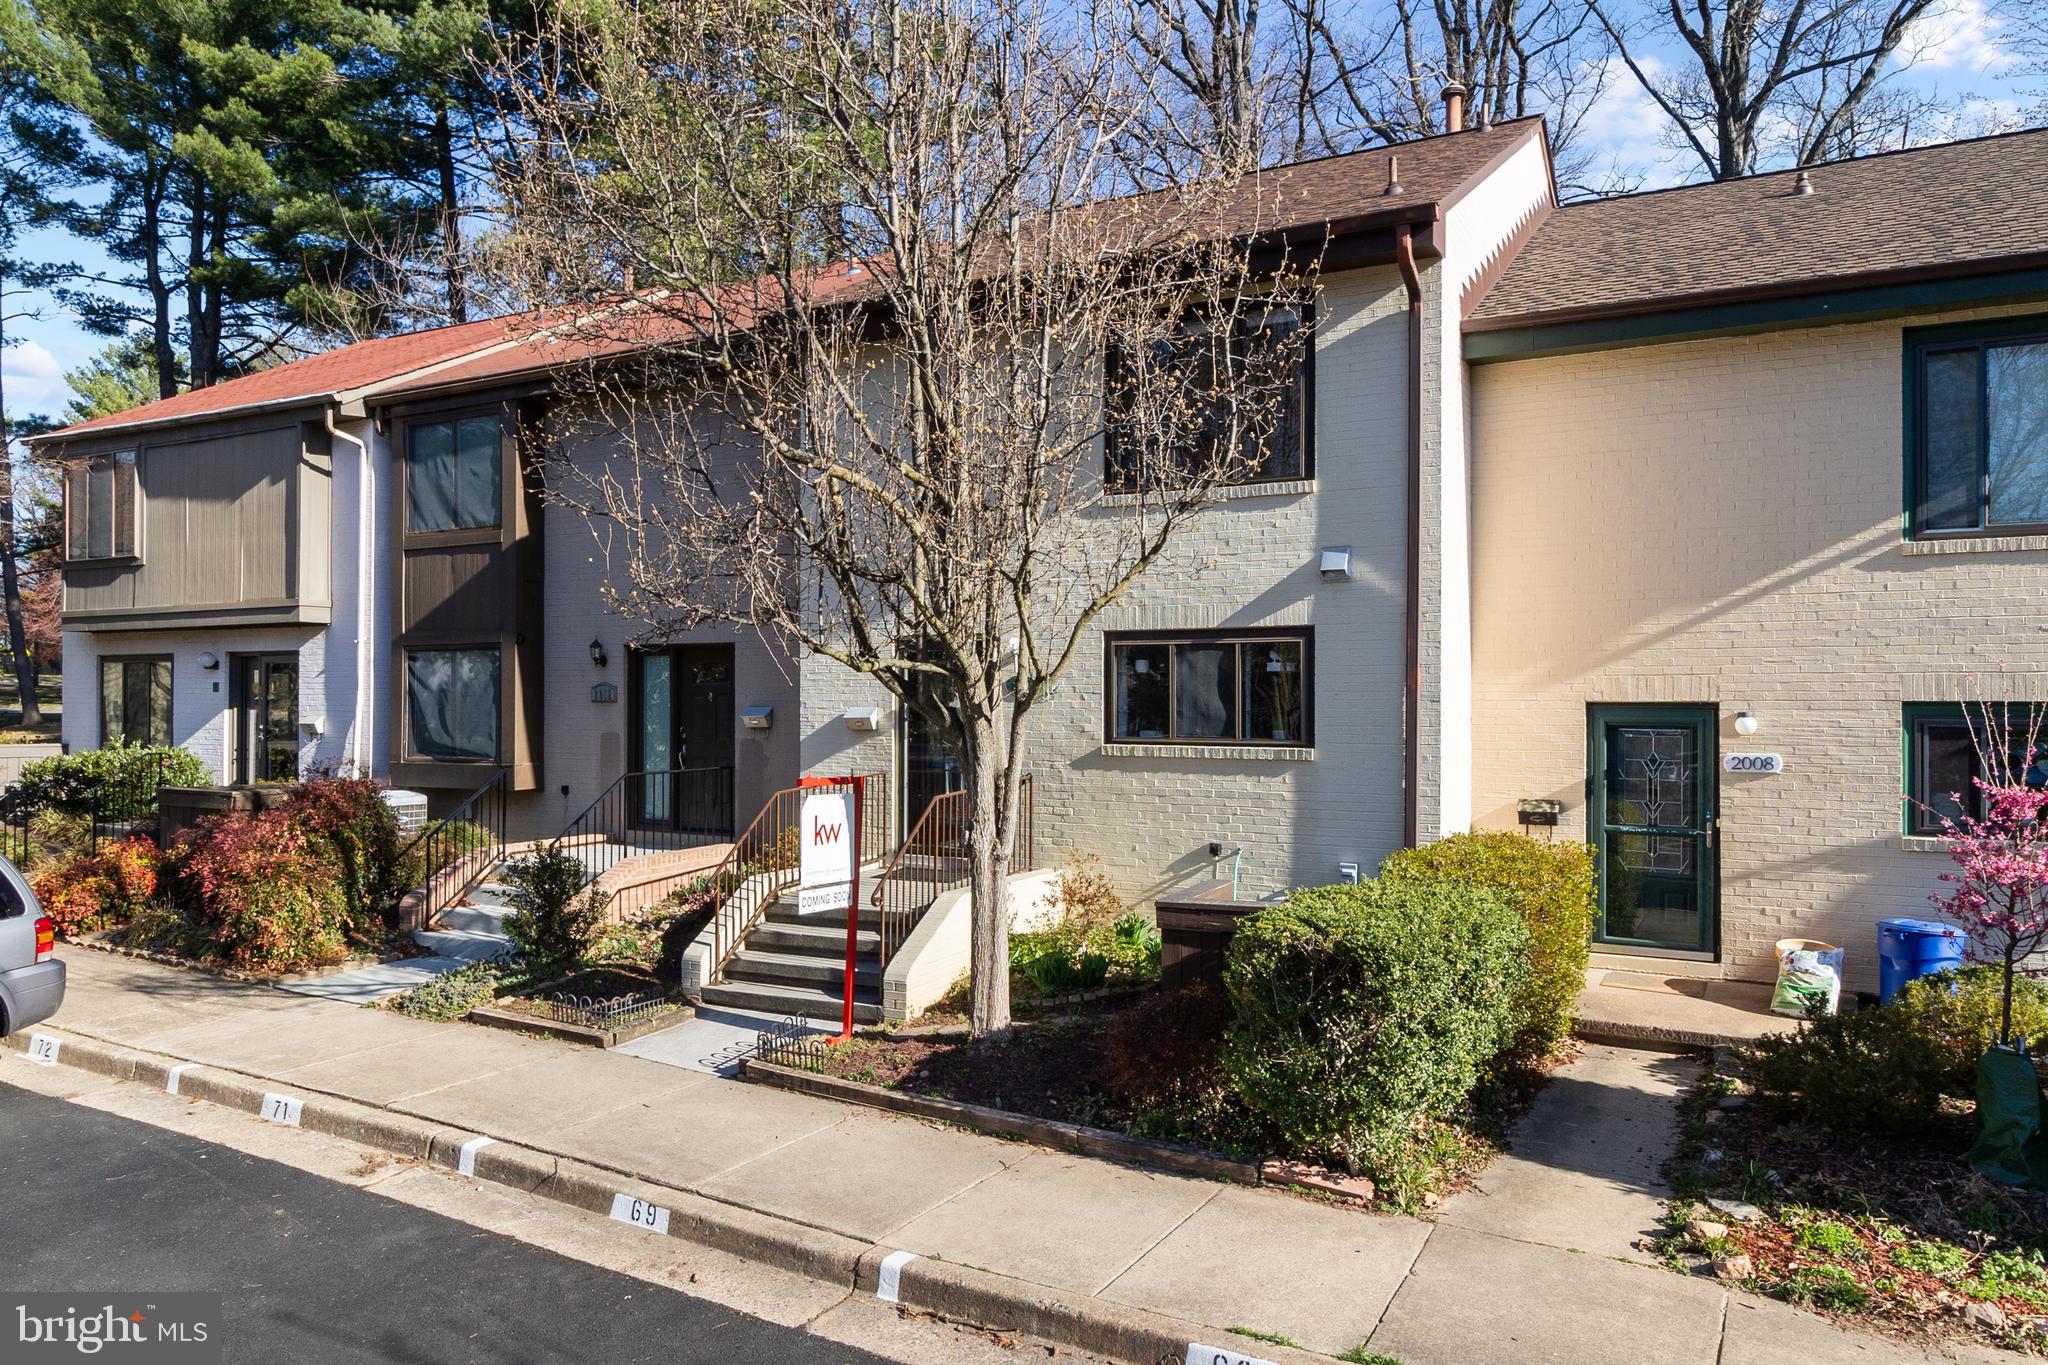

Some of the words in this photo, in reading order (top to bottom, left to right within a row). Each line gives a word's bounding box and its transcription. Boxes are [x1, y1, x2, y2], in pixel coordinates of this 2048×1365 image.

[1731, 756, 1775, 770] 2008
[814, 815, 842, 846] kw
[801, 893, 830, 908] COMING
[38, 1039, 52, 1058] 72
[273, 1100, 288, 1120] 71
[631, 1199, 657, 1226] 69
